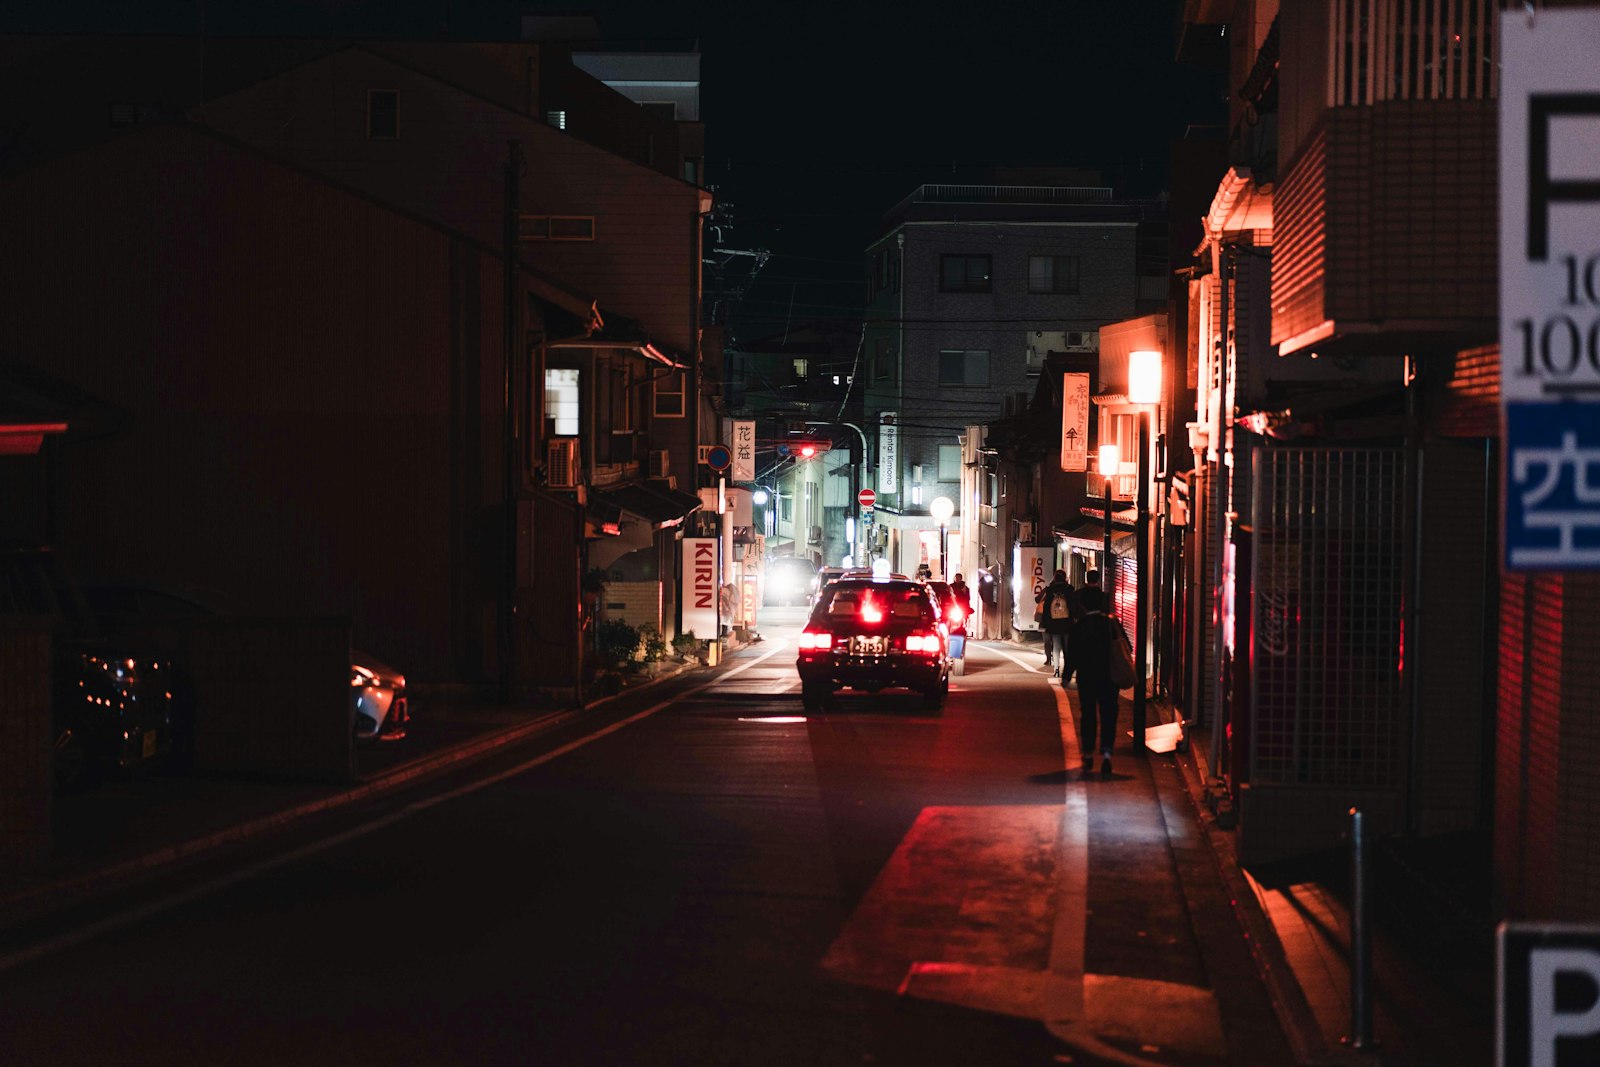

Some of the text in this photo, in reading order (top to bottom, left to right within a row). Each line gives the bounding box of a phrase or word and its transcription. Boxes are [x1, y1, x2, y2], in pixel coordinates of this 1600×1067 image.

[886, 428, 895, 485] Rental Kimono
[695, 543, 712, 609] KIRIN
[1034, 558, 1045, 595] DyDo
[1530, 948, 1600, 1067] P
